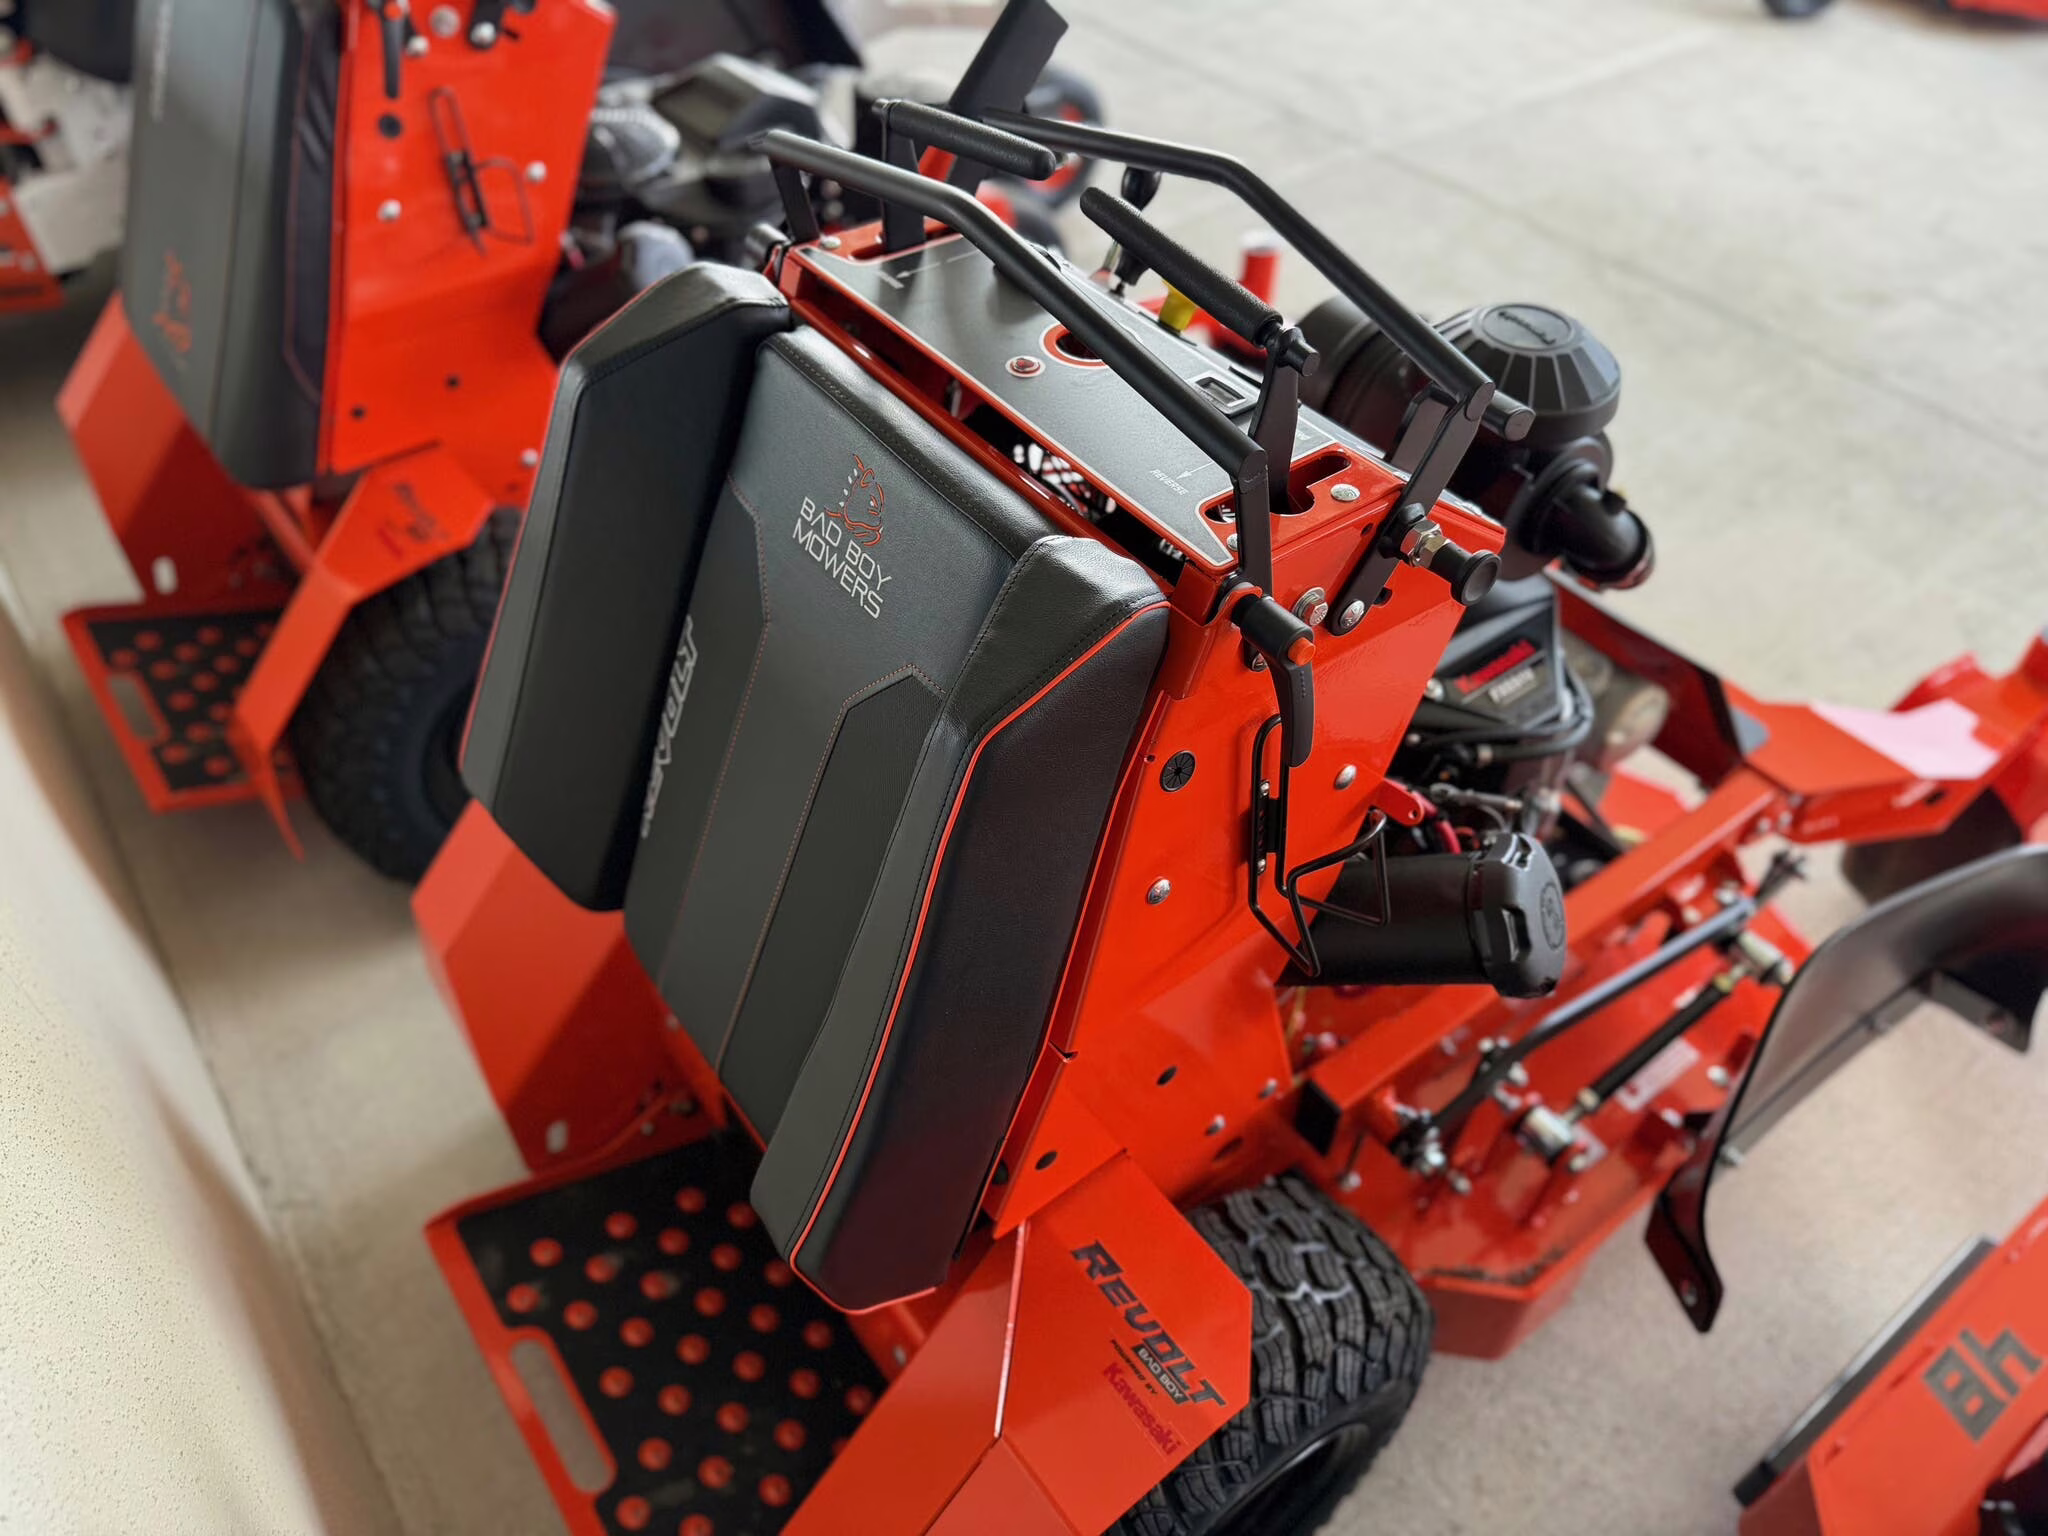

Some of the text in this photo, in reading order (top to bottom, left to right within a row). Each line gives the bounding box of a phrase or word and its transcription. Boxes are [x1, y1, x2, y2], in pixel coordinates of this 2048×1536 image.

[792, 518, 884, 619] MOWERS
[799, 496, 892, 591] BAD BOY
[1070, 1239, 1227, 1408] REVOLT
[1110, 1338, 1158, 1395] POWERED BY
[1103, 1361, 1182, 1456] Kawasaki
[1137, 1347, 1184, 1399] BAD BOY
